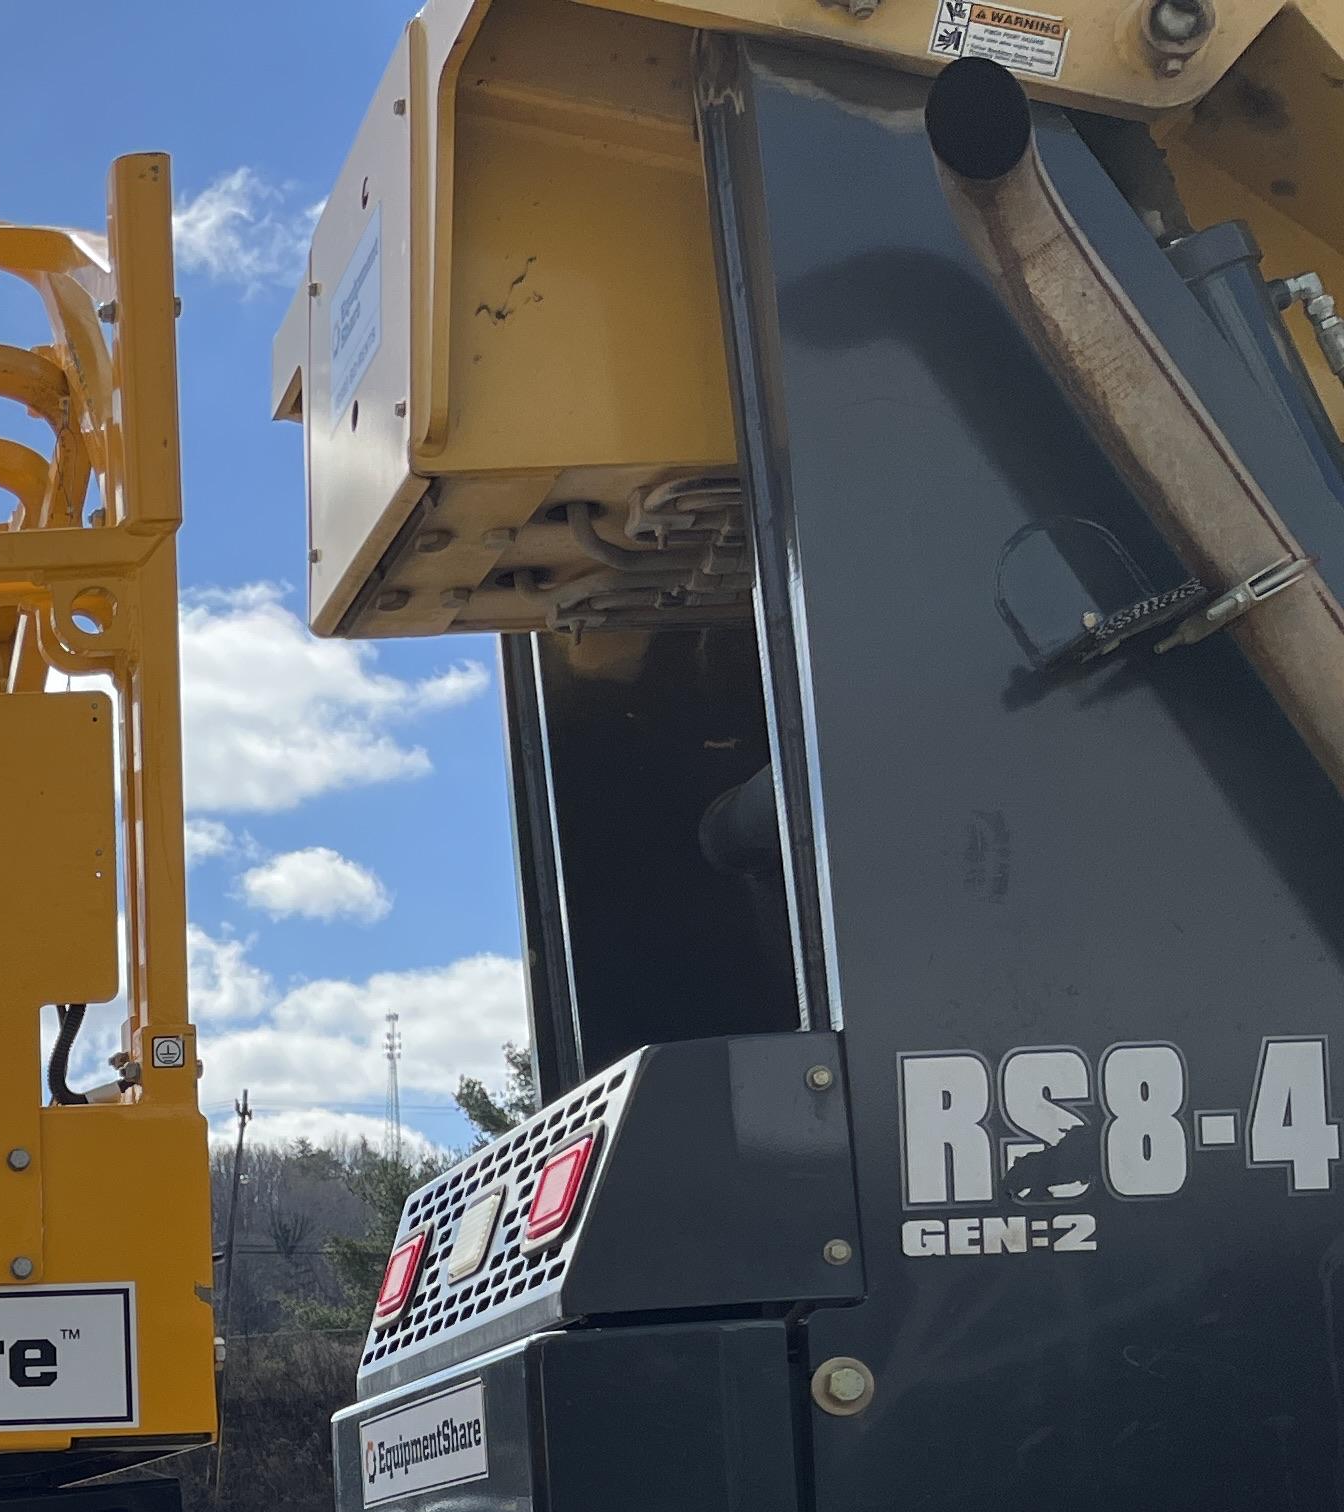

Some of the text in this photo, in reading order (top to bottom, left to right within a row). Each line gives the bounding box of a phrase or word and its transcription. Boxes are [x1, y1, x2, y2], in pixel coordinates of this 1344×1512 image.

[991, 10, 1061, 35] WARNING
[901, 1213, 1098, 1257] GEN:2
[378, 1417, 482, 1480] EquipmentShare
